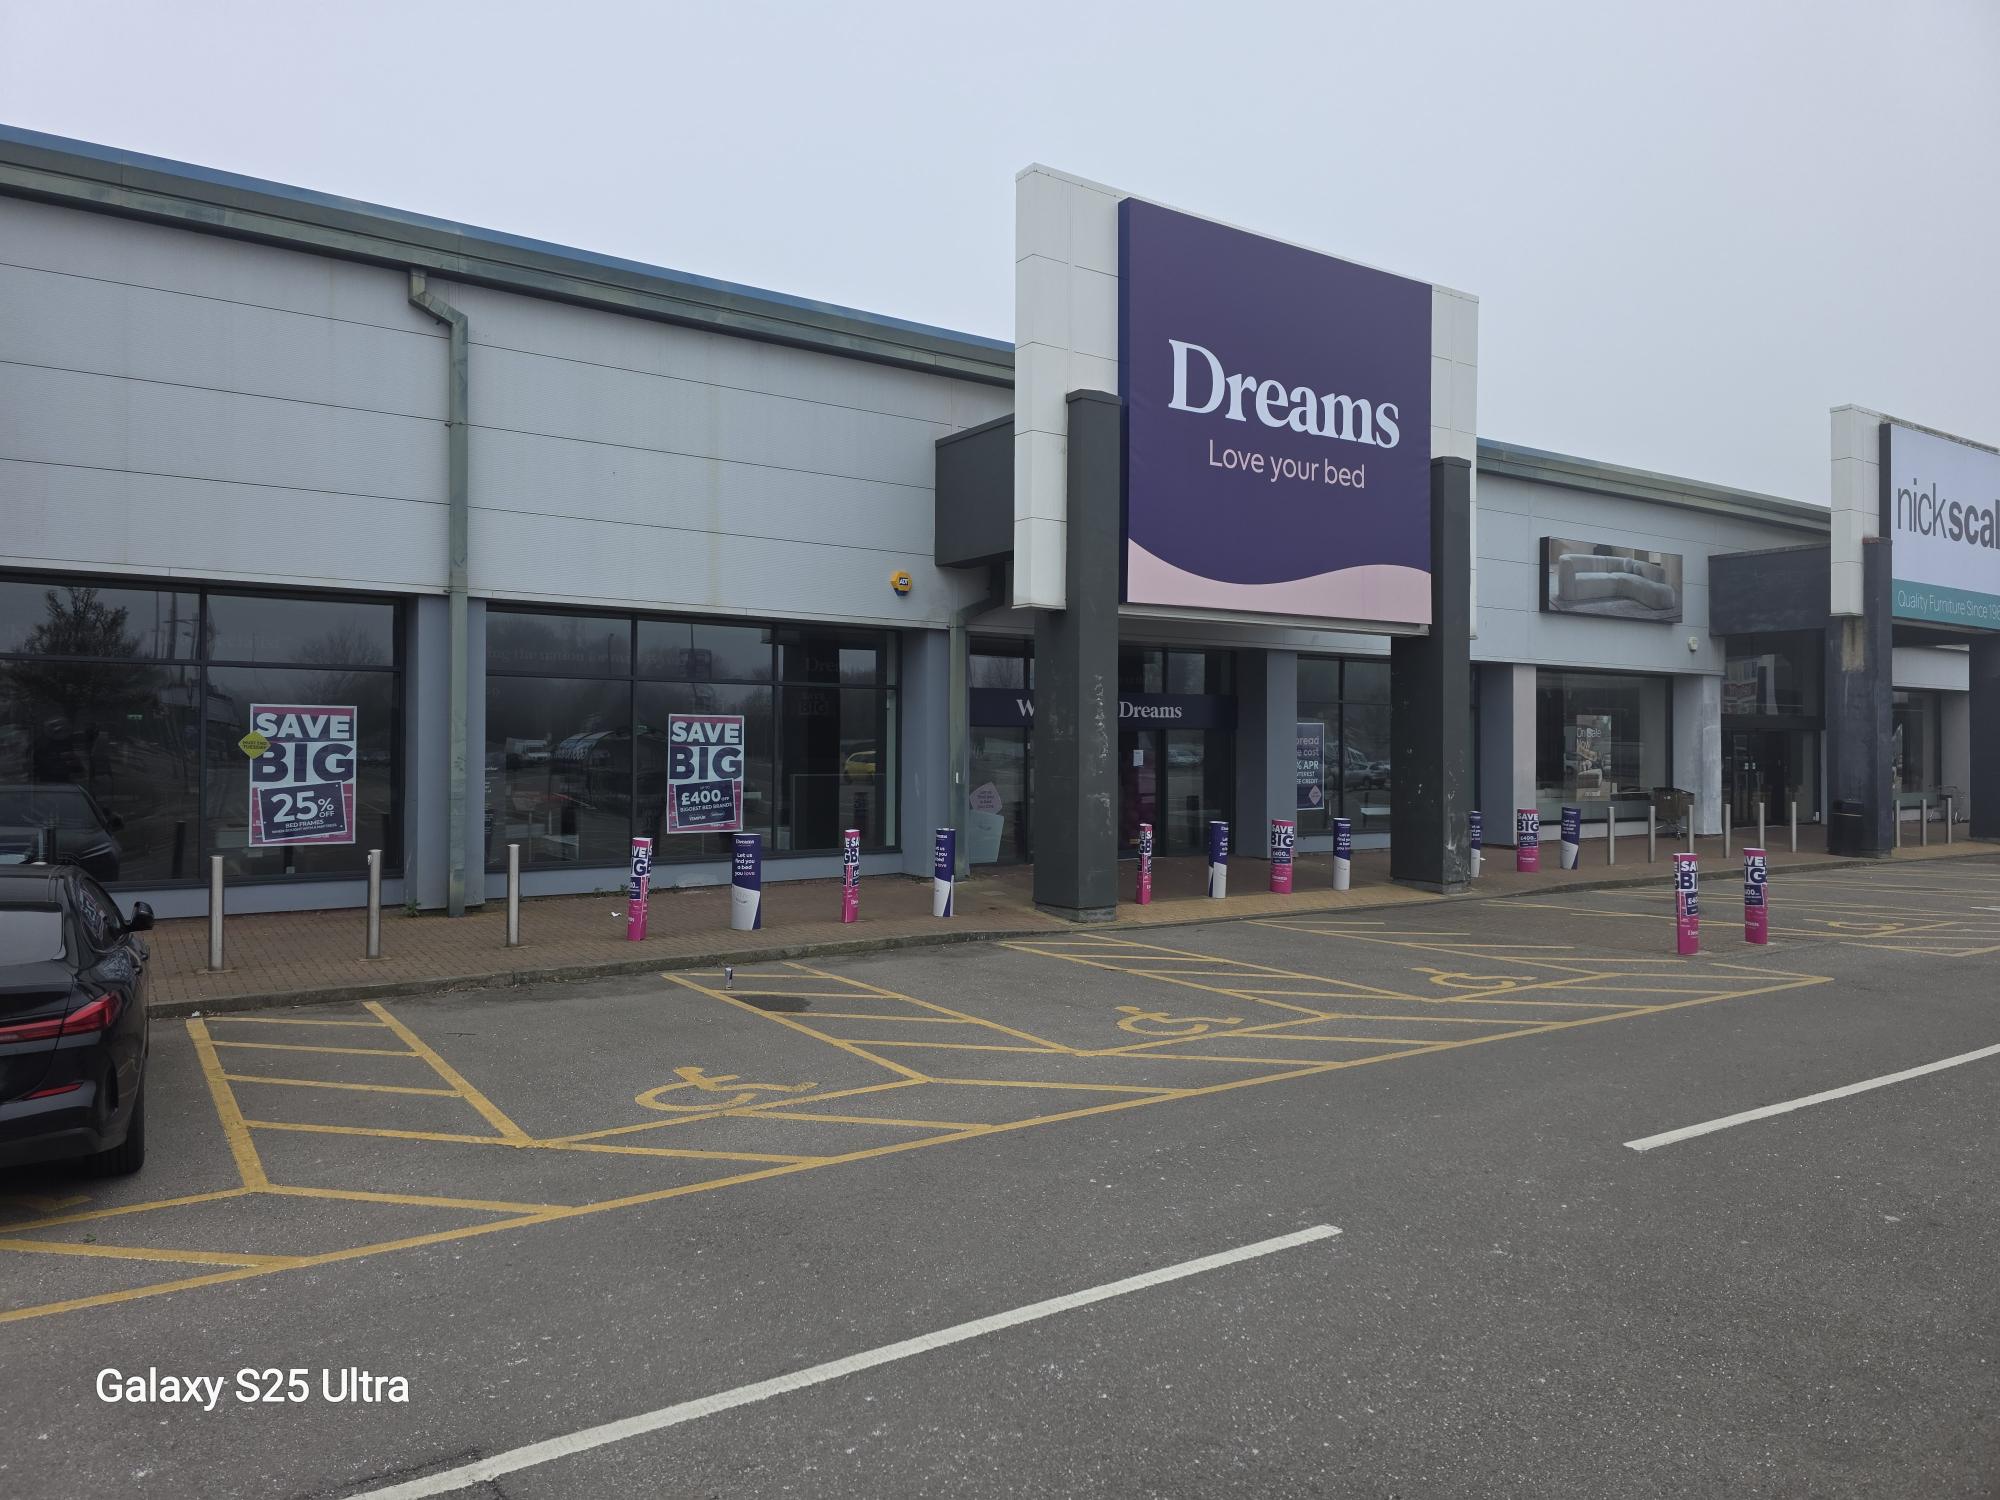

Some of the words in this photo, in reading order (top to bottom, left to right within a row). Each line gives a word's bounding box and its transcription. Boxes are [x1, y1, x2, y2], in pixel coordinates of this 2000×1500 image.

[1168, 338, 1400, 449] Dreams
[1208, 439, 1264, 473] Love
[1270, 455, 1319, 483] your
[1324, 458, 1365, 488] bed
[1898, 590, 1928, 614] Quality
[1929, 594, 1966, 616] Furniture
[1966, 600, 1988, 618] Since
[1119, 701, 1182, 718] Dreams
[256, 712, 350, 739] SAVE
[671, 721, 740, 744] SAVE
[1303, 748, 1319, 756] cost
[252, 743, 354, 782] BIG
[670, 747, 742, 780] BIG
[1304, 760, 1319, 770] APR
[682, 790, 721, 805] £400
[270, 791, 334, 823] 25%
[1517, 812, 1538, 821] SAVE
[1272, 824, 1294, 834] SAVE
[1517, 821, 1539, 831] BIG
[1272, 834, 1294, 847] BIG
[632, 846, 646, 858] VE
